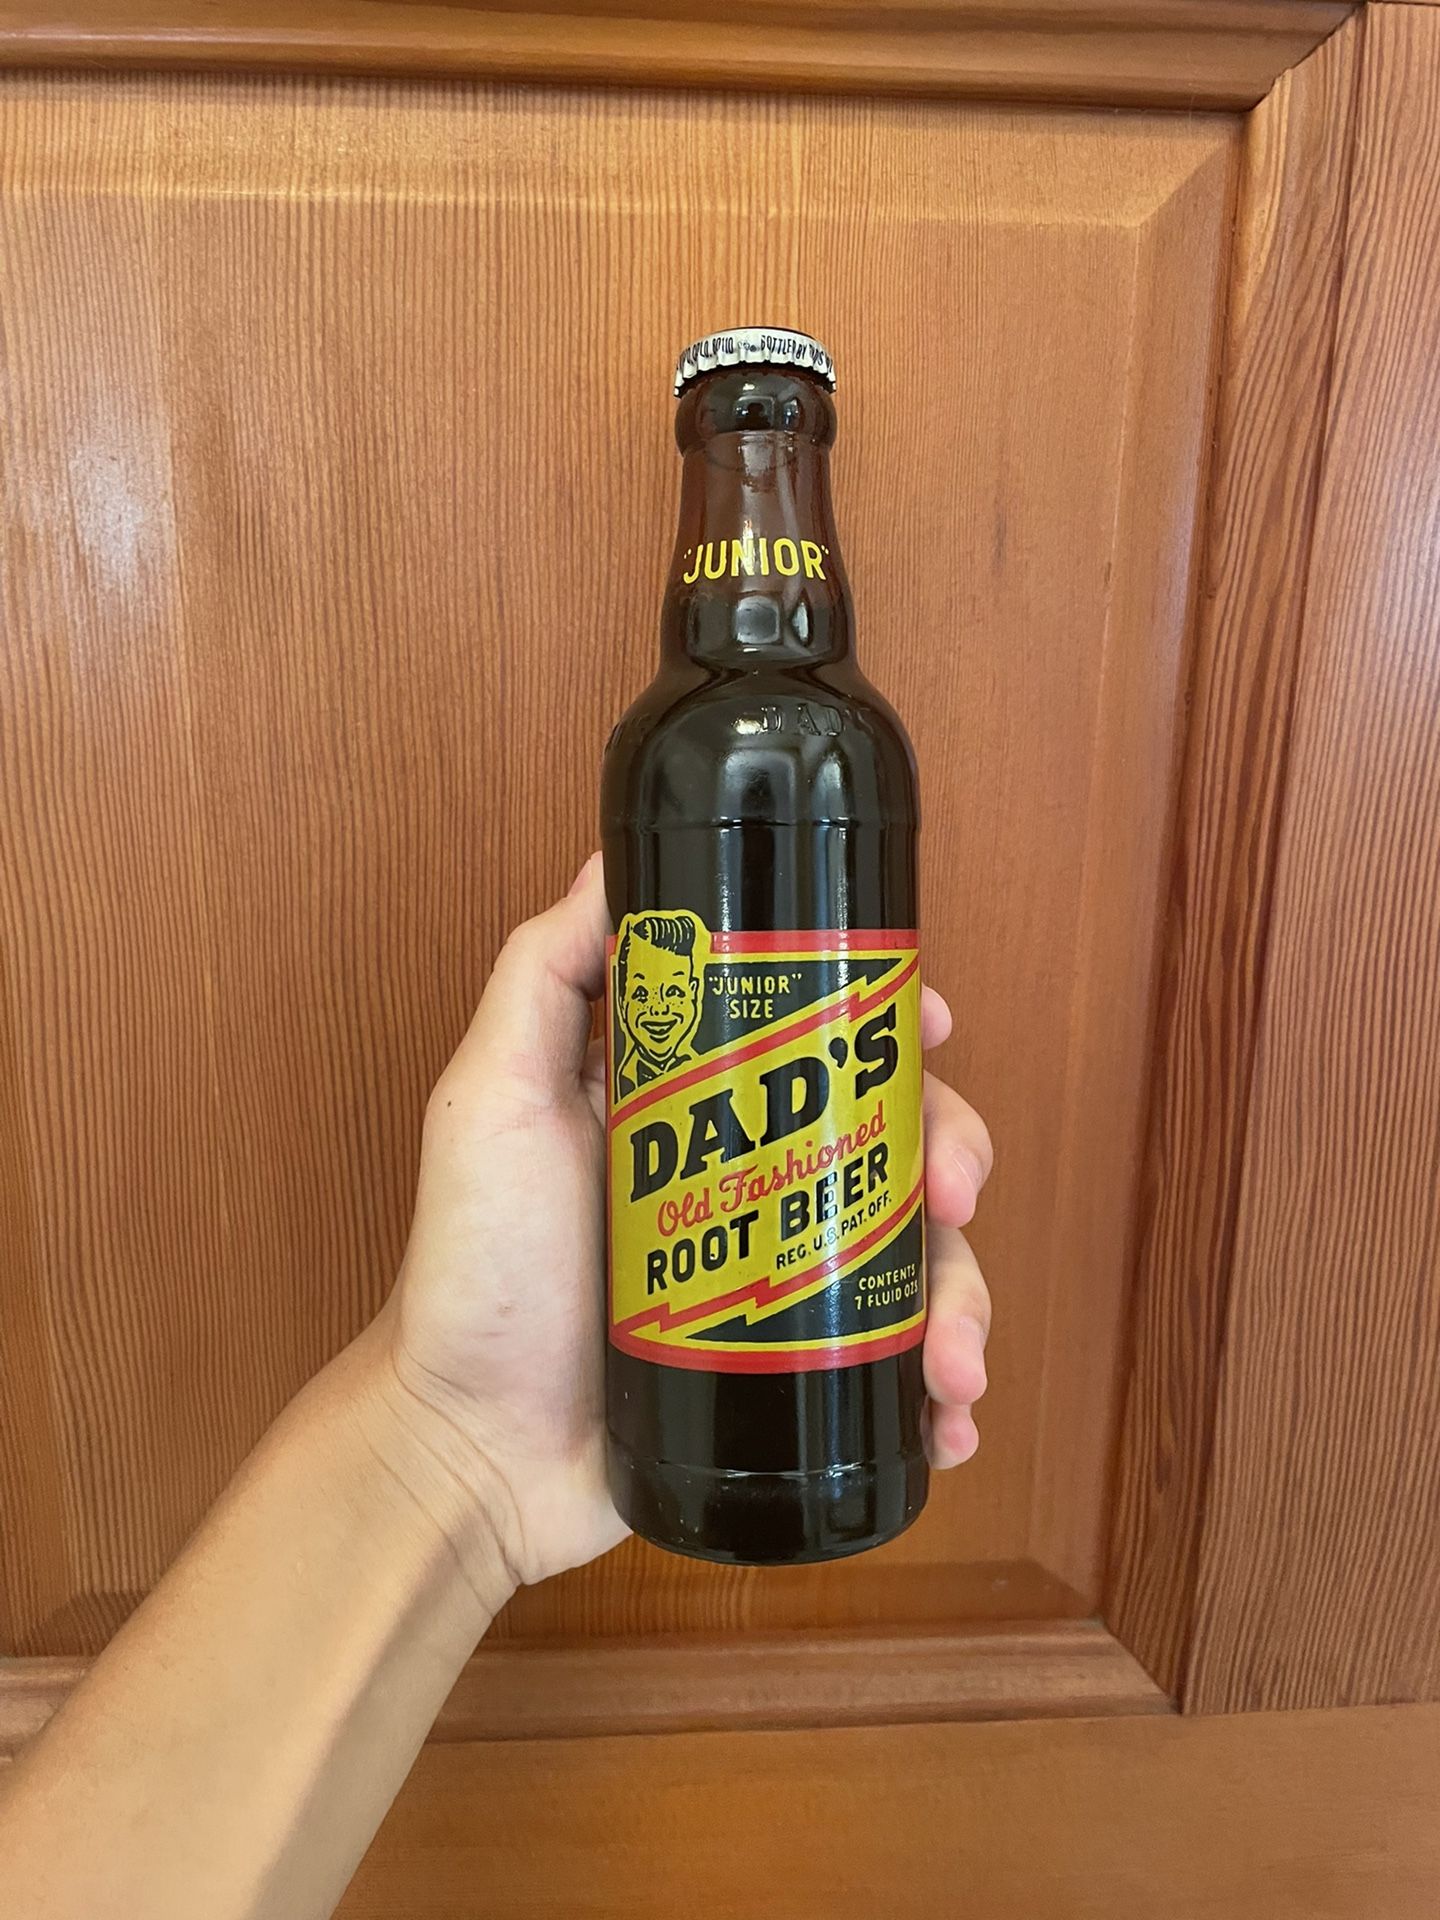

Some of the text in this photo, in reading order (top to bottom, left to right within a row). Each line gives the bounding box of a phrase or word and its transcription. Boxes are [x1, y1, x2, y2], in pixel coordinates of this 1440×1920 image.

[683, 537, 829, 584] "JUNIOR"
[708, 973, 802, 996] "JUNIOR"
[729, 999, 774, 1019] SIZE
[630, 1002, 899, 1203] DAD'S
[658, 1099, 887, 1238] Old Fashioned
[647, 1142, 888, 1295] ROOT BEER
[776, 1243, 812, 1270] REG.
[868, 1190, 892, 1217] OFF.
[854, 1295, 863, 1310] 7
[867, 1287, 902, 1308] FLUID
[858, 1263, 915, 1291] CONTENTS
